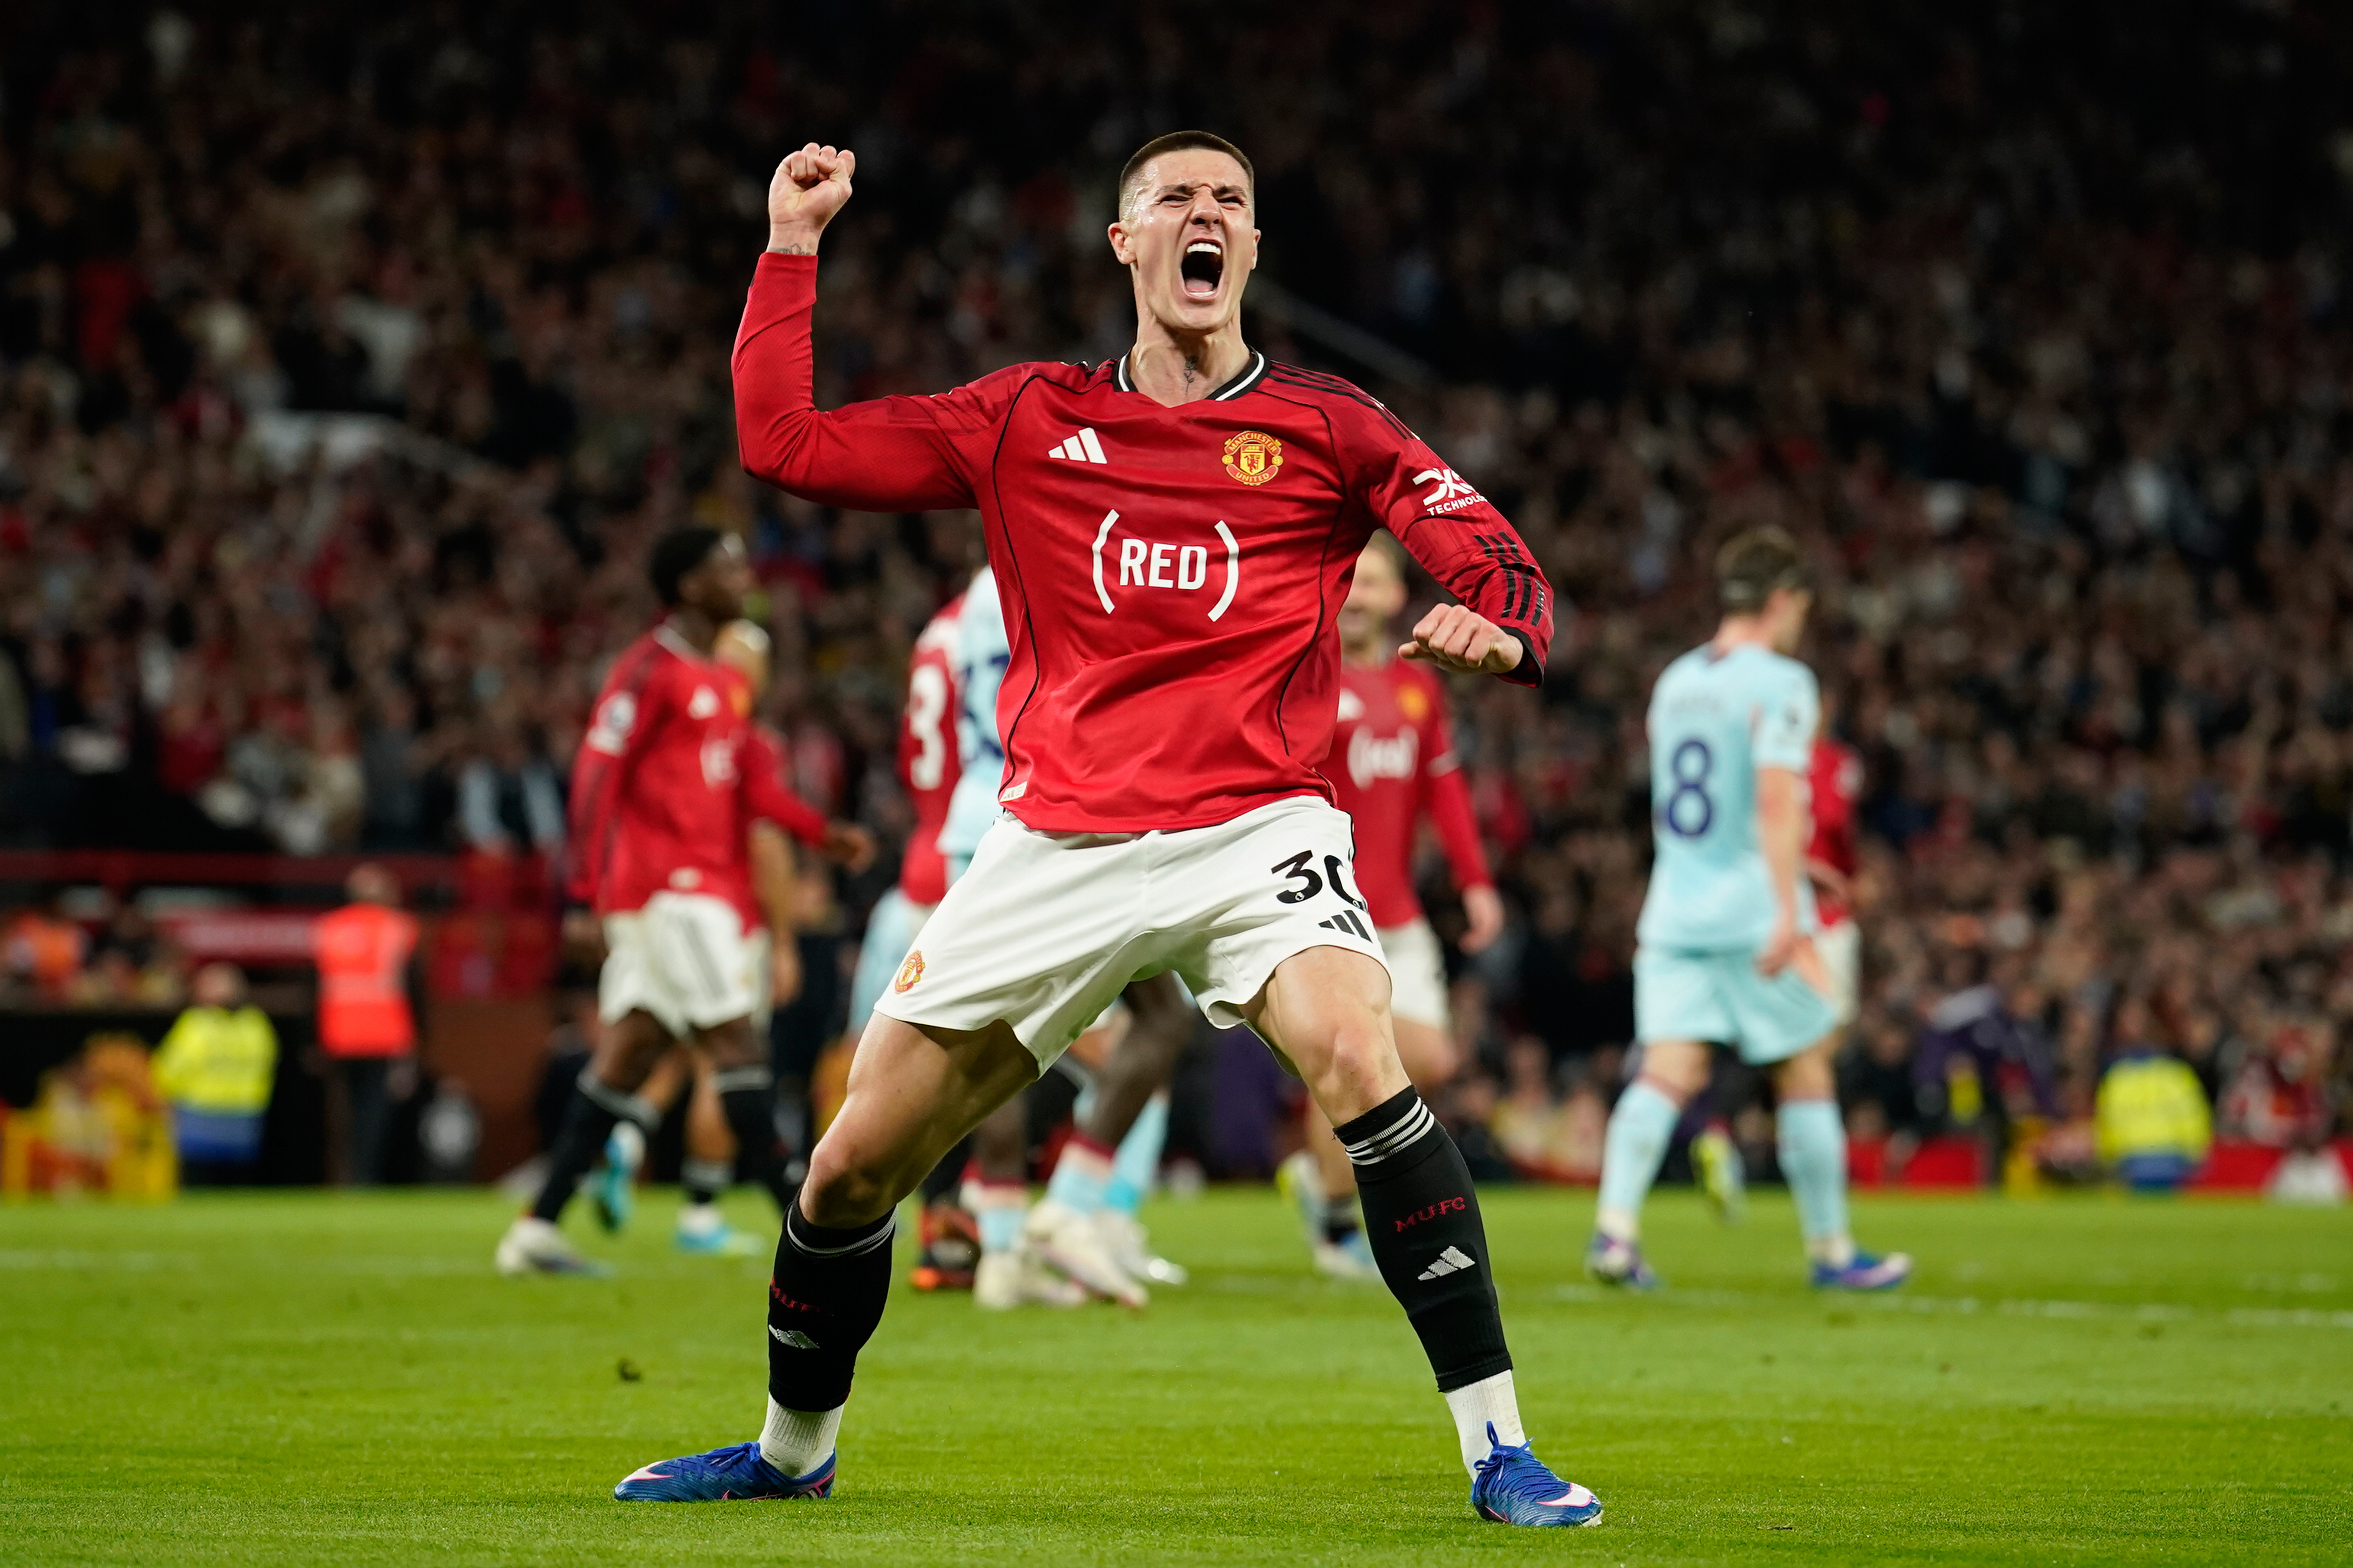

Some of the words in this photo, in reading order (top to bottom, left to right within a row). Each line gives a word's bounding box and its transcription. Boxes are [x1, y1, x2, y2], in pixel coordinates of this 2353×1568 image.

[1229, 433, 1278, 452] MANCHESTER
[1236, 472, 1269, 482] UNITED
[1427, 495, 1488, 516] TECHNOLO
[1667, 738, 1713, 839] 8
[1395, 1197, 1466, 1232] MUFC
[770, 1275, 834, 1317] MUF
